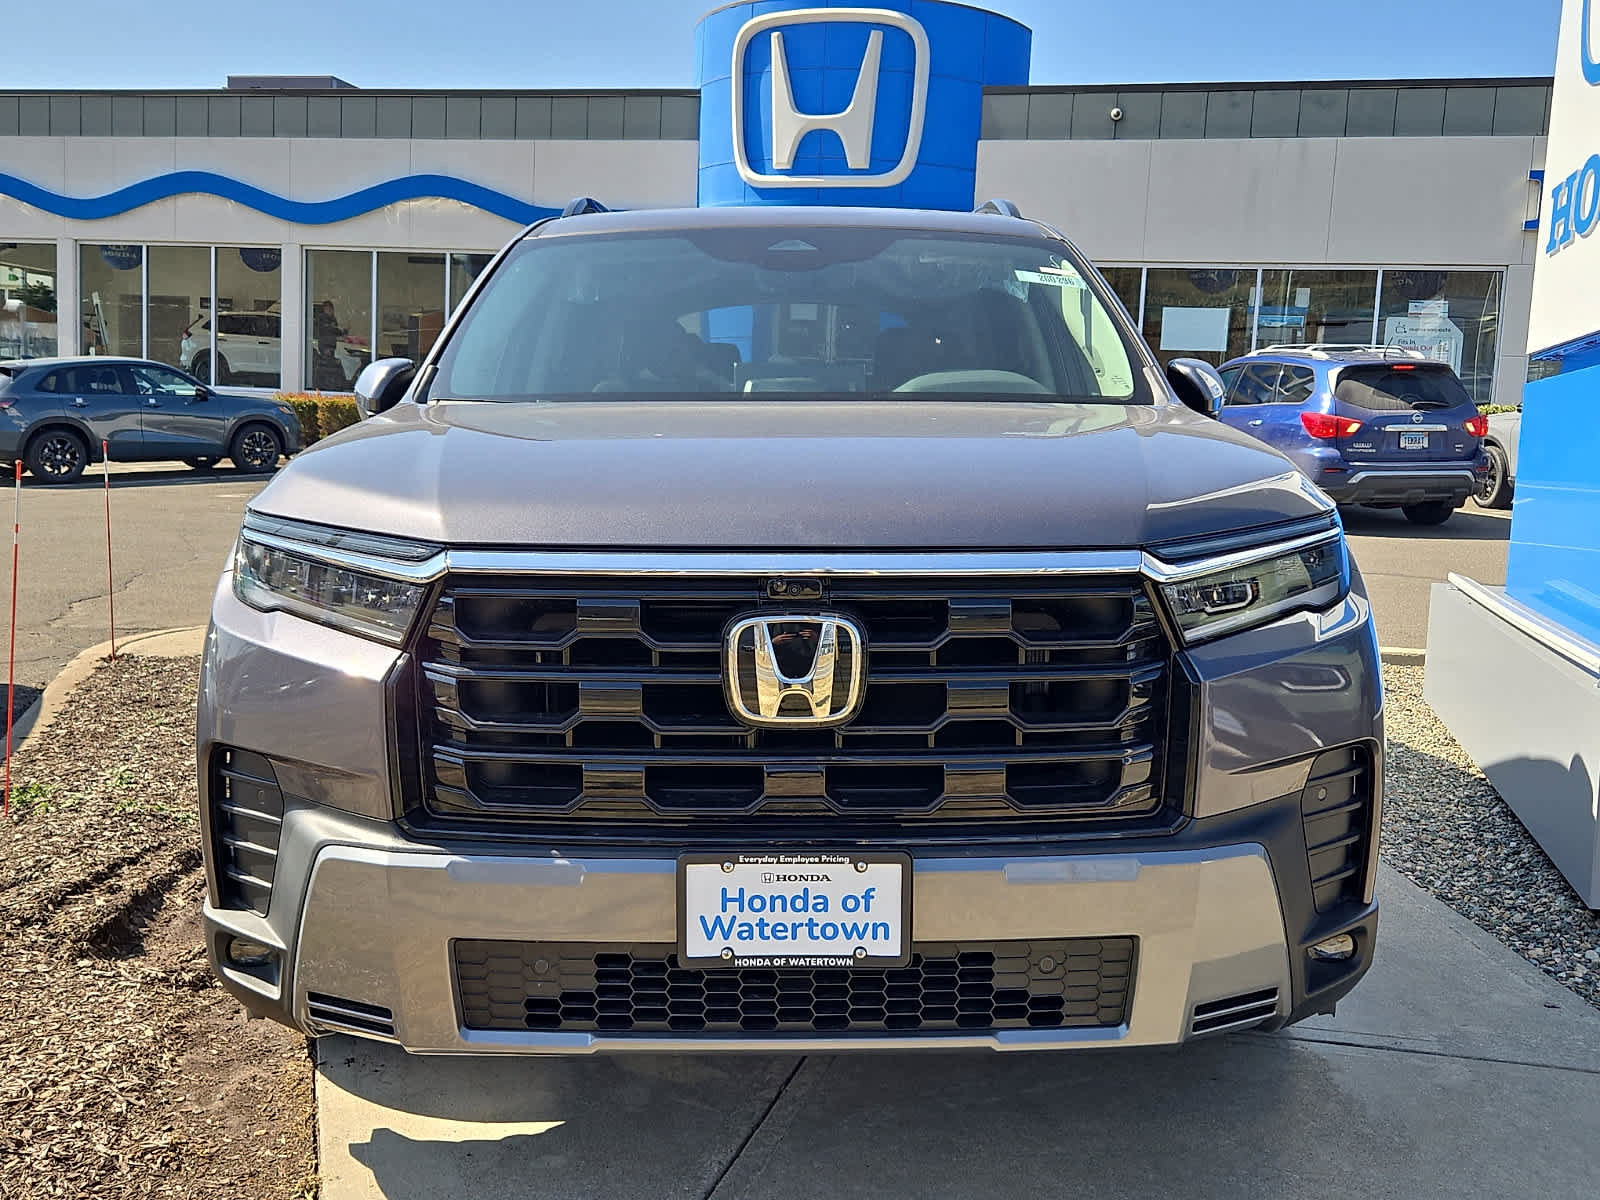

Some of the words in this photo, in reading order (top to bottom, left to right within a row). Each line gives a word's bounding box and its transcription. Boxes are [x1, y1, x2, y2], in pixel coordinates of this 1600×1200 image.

[1545, 153, 1600, 257] HO
[739, 855, 778, 865] Everyday
[779, 855, 820, 865] Employee
[821, 855, 850, 865] Pricing
[775, 874, 832, 882] HONDA
[720, 887, 829, 913] Honda
[841, 887, 876, 913] of
[699, 914, 890, 941] Watertown
[735, 958, 771, 967] HONDA
[773, 958, 788, 967] OF
[788, 957, 854, 967] WATERTOWN
